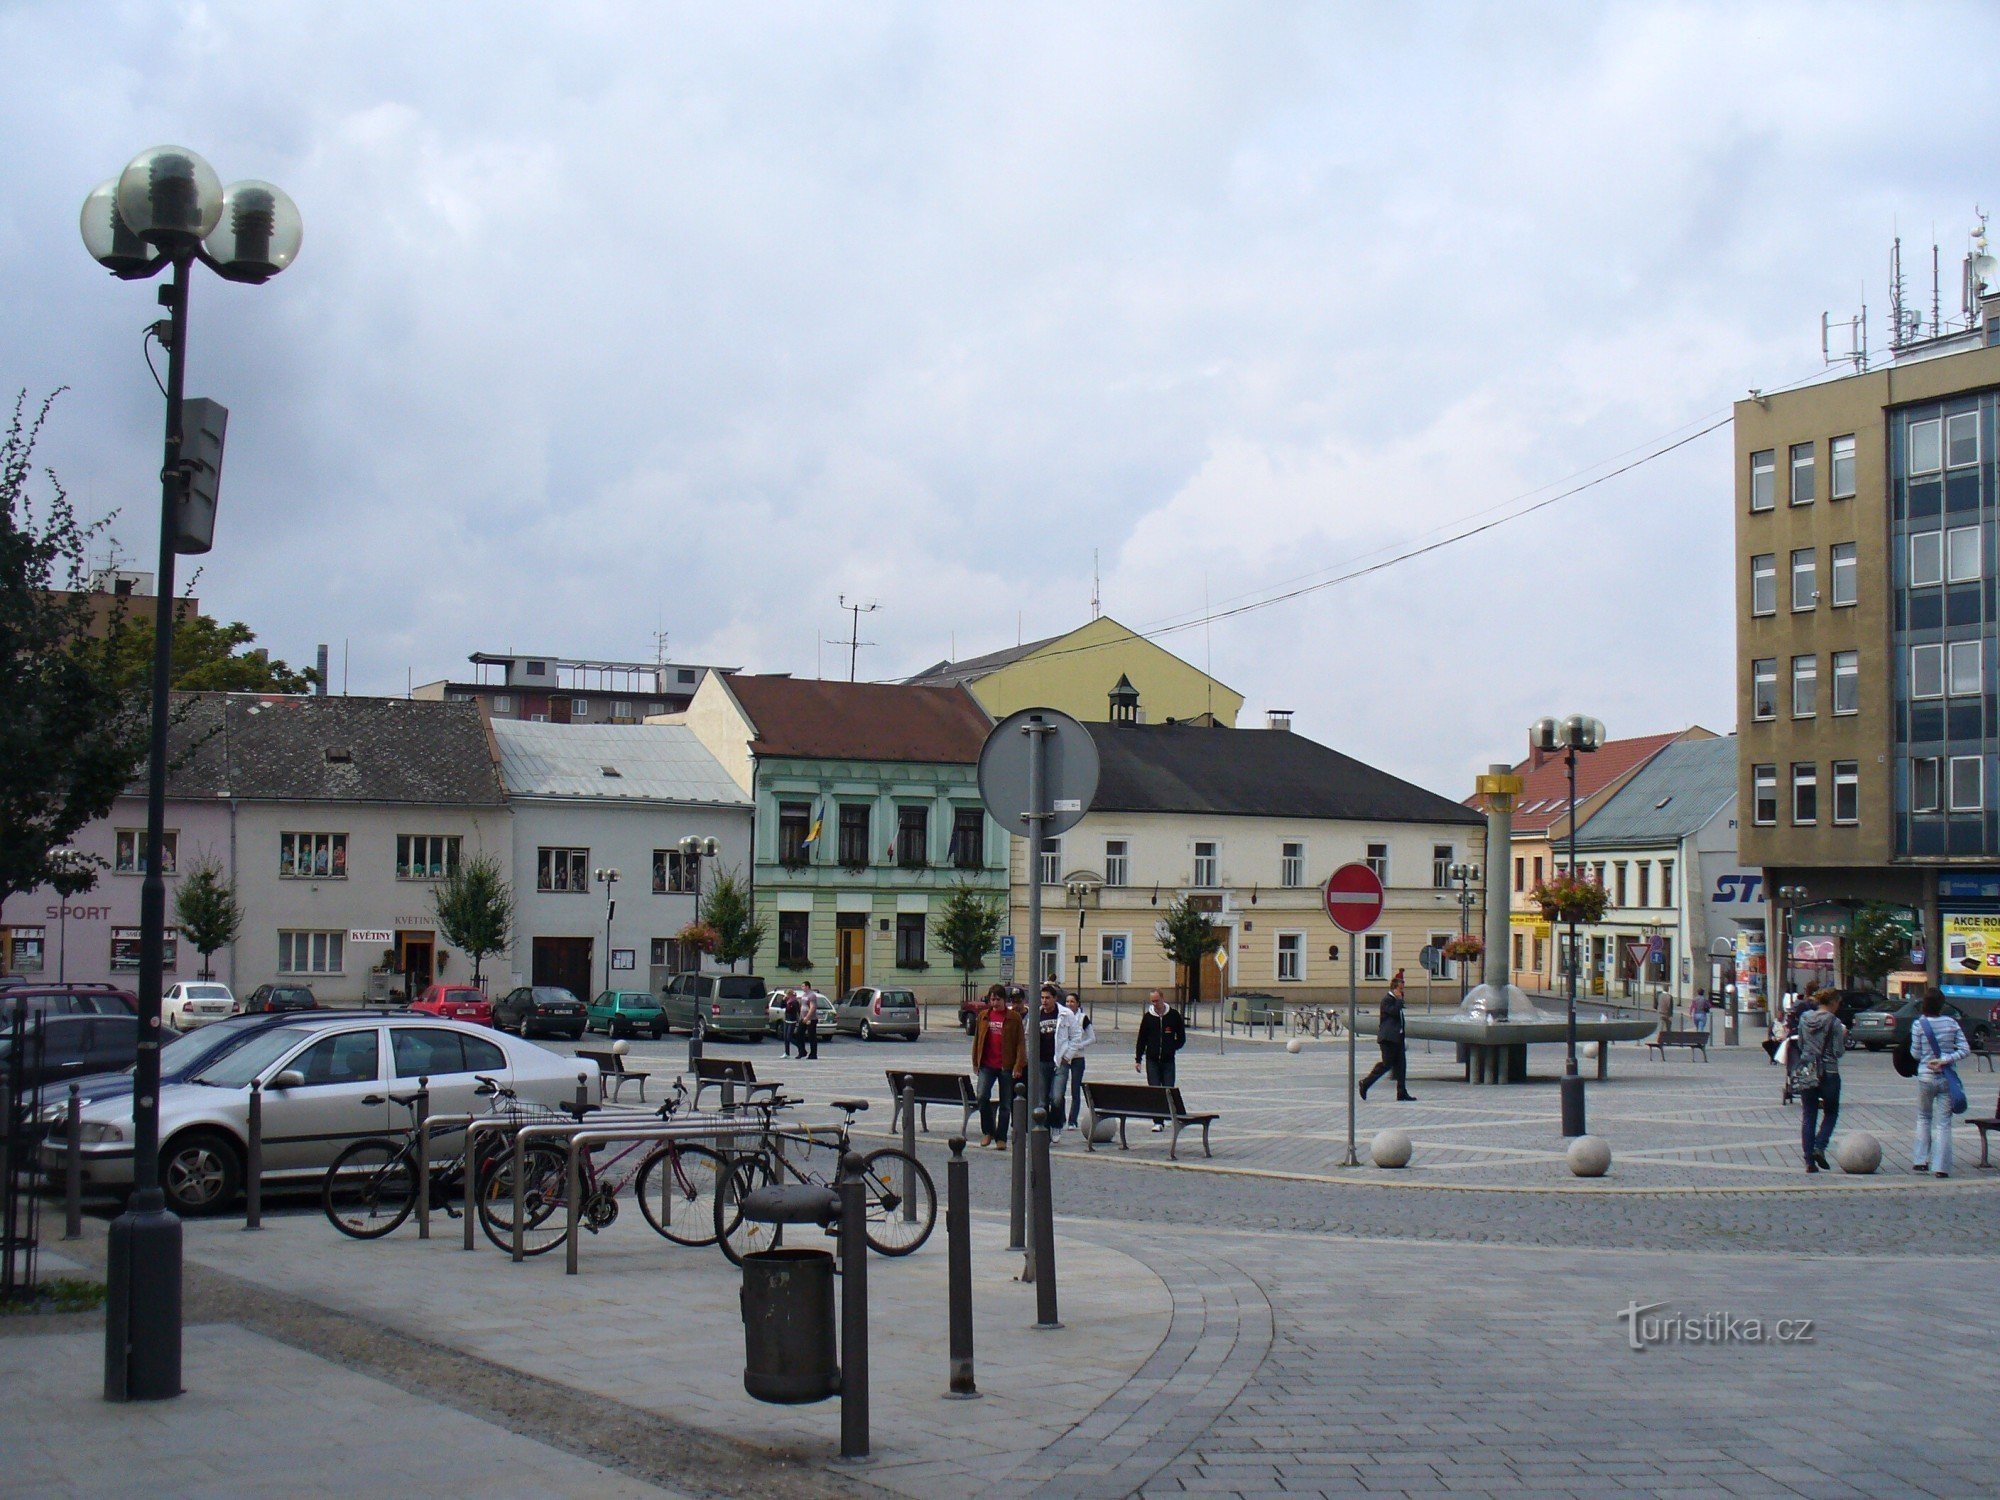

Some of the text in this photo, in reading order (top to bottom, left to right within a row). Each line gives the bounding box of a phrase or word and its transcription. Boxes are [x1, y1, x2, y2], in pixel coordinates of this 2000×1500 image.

[46, 906, 112, 920] SPORT
[1953, 916, 1981, 926] AKCE
[352, 930, 391, 940] KVĚTINY
